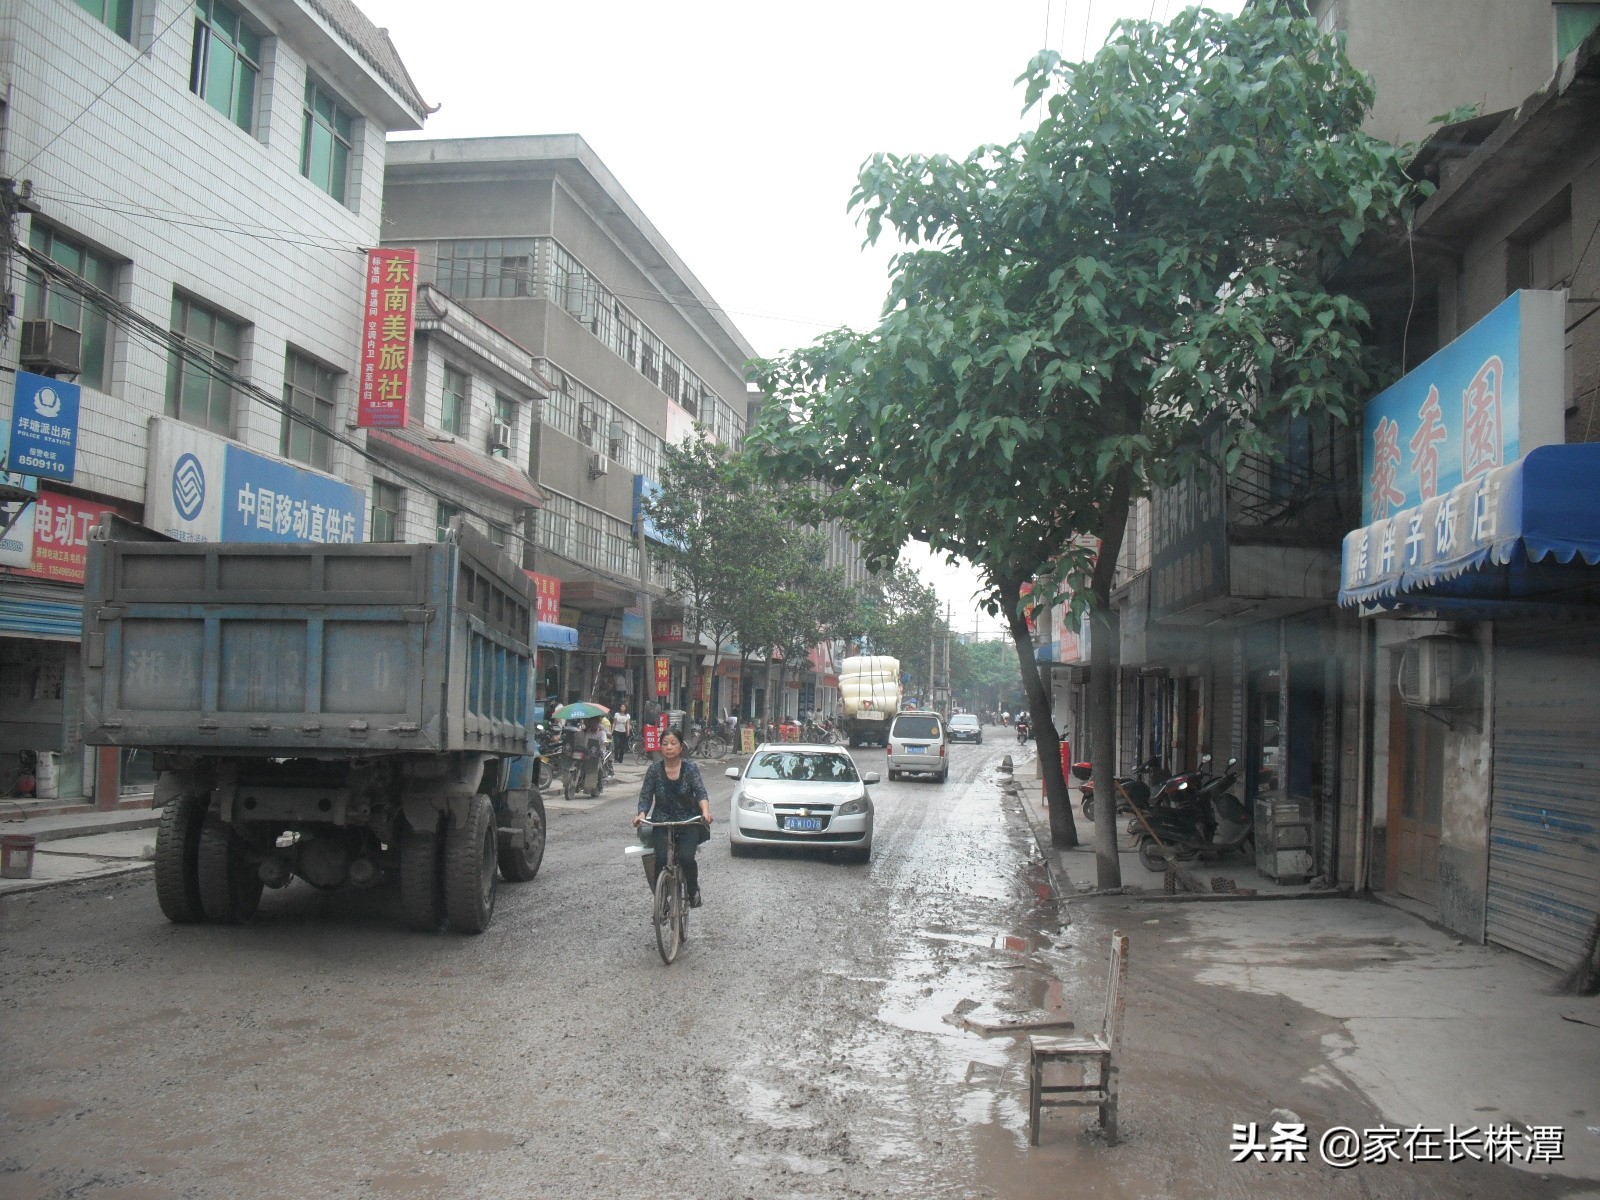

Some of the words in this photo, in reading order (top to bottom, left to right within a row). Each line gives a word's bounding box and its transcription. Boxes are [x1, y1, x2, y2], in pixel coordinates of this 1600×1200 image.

[378, 256, 411, 401] 东南美旅社
[17, 429, 41, 440] POLICE
[18, 416, 72, 440] 坪塘派出所
[18, 454, 65, 473] 8509110
[237, 482, 356, 543] 中国移动直供店
